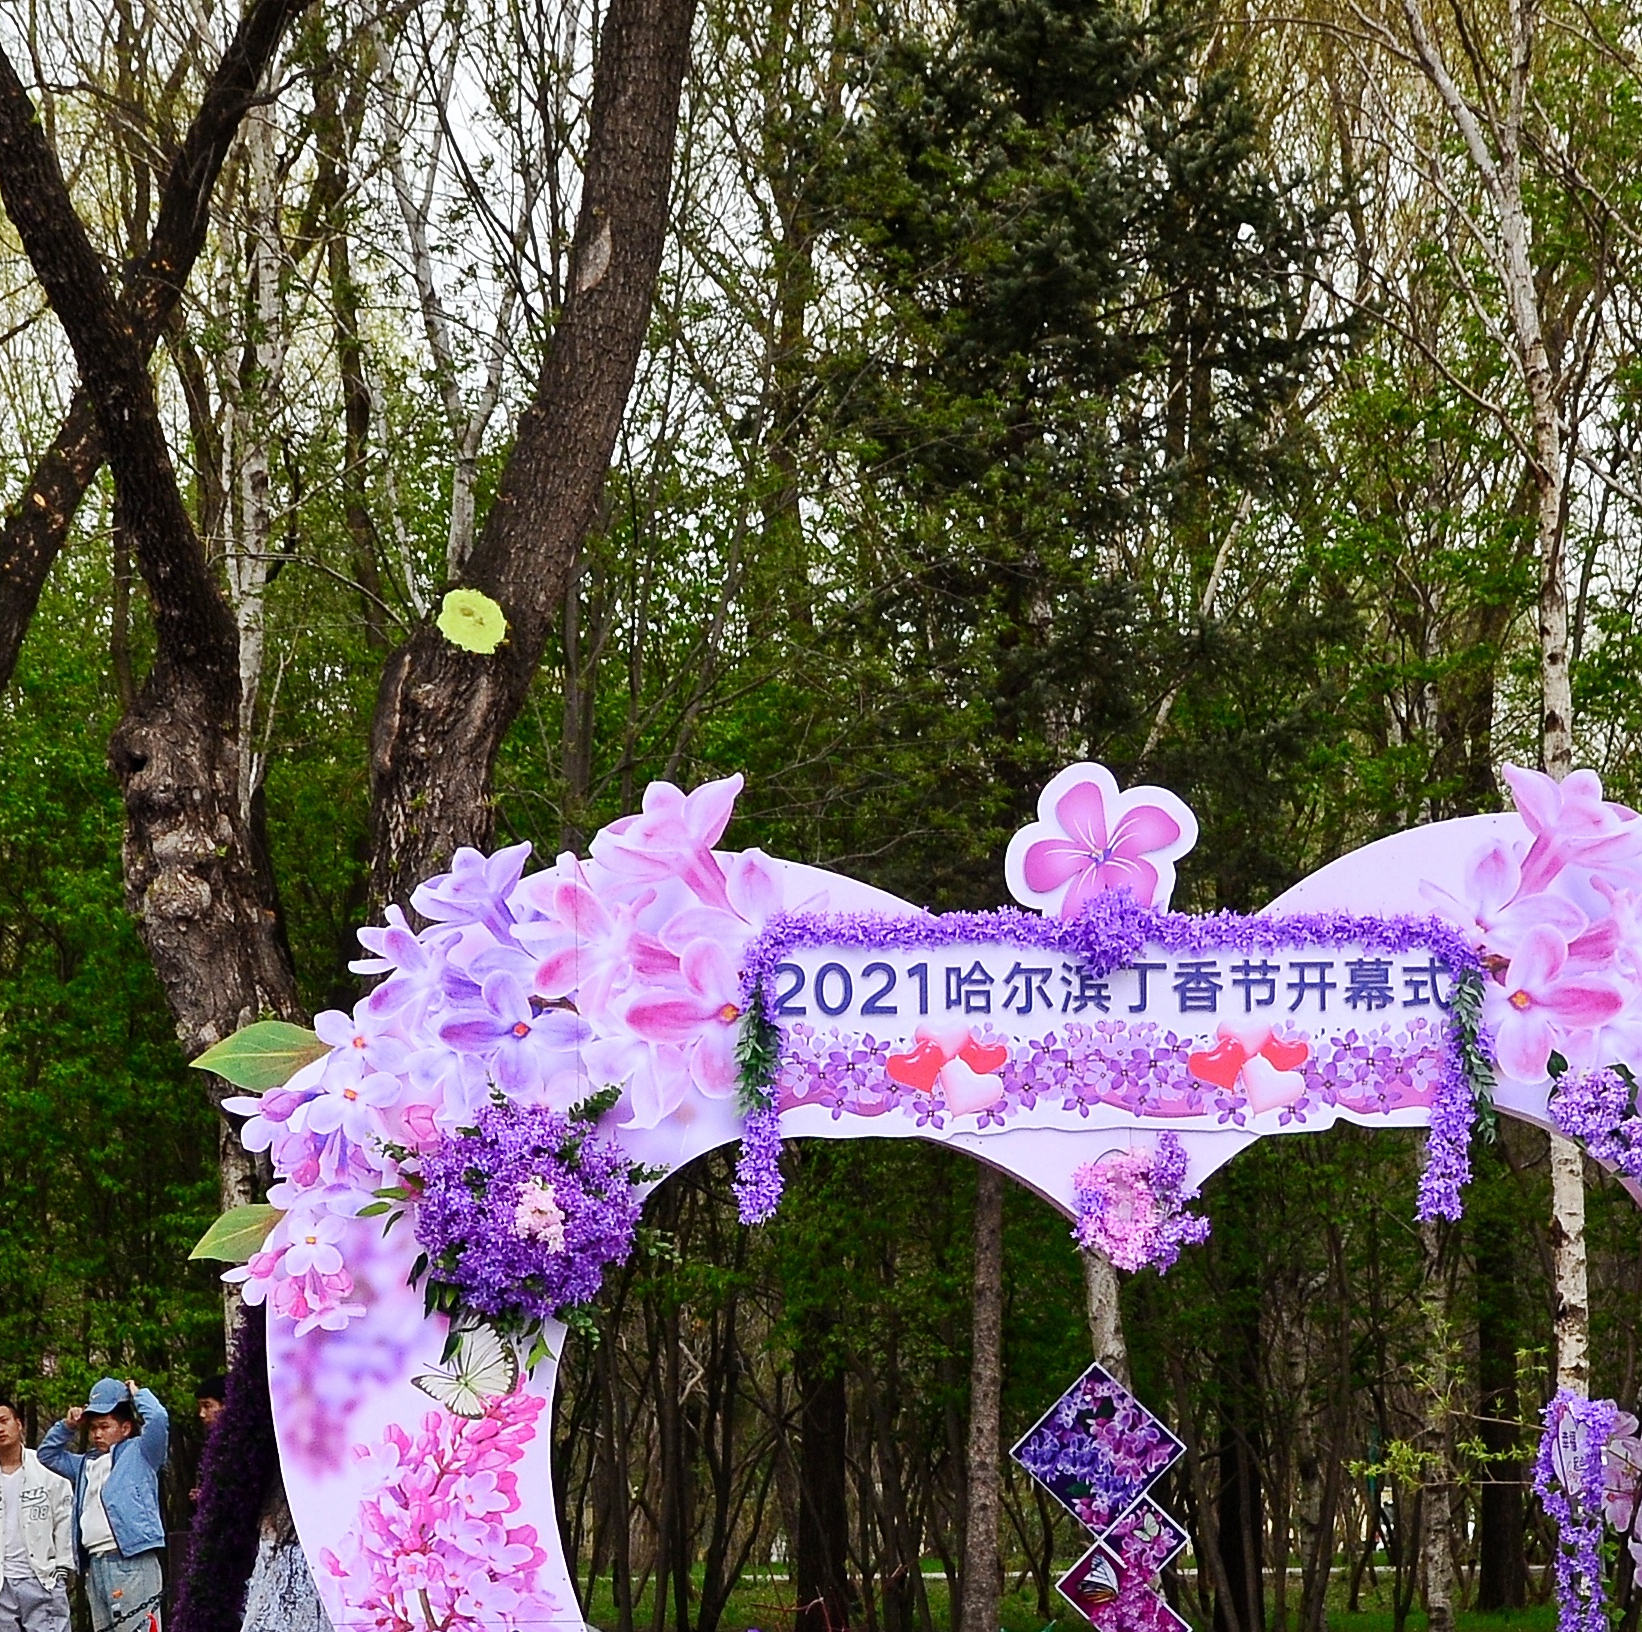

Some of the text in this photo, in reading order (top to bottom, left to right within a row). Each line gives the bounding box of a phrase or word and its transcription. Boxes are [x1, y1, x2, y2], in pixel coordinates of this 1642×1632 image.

[773, 957, 1453, 1018] 2021哈尔滨丁香节开幕式
